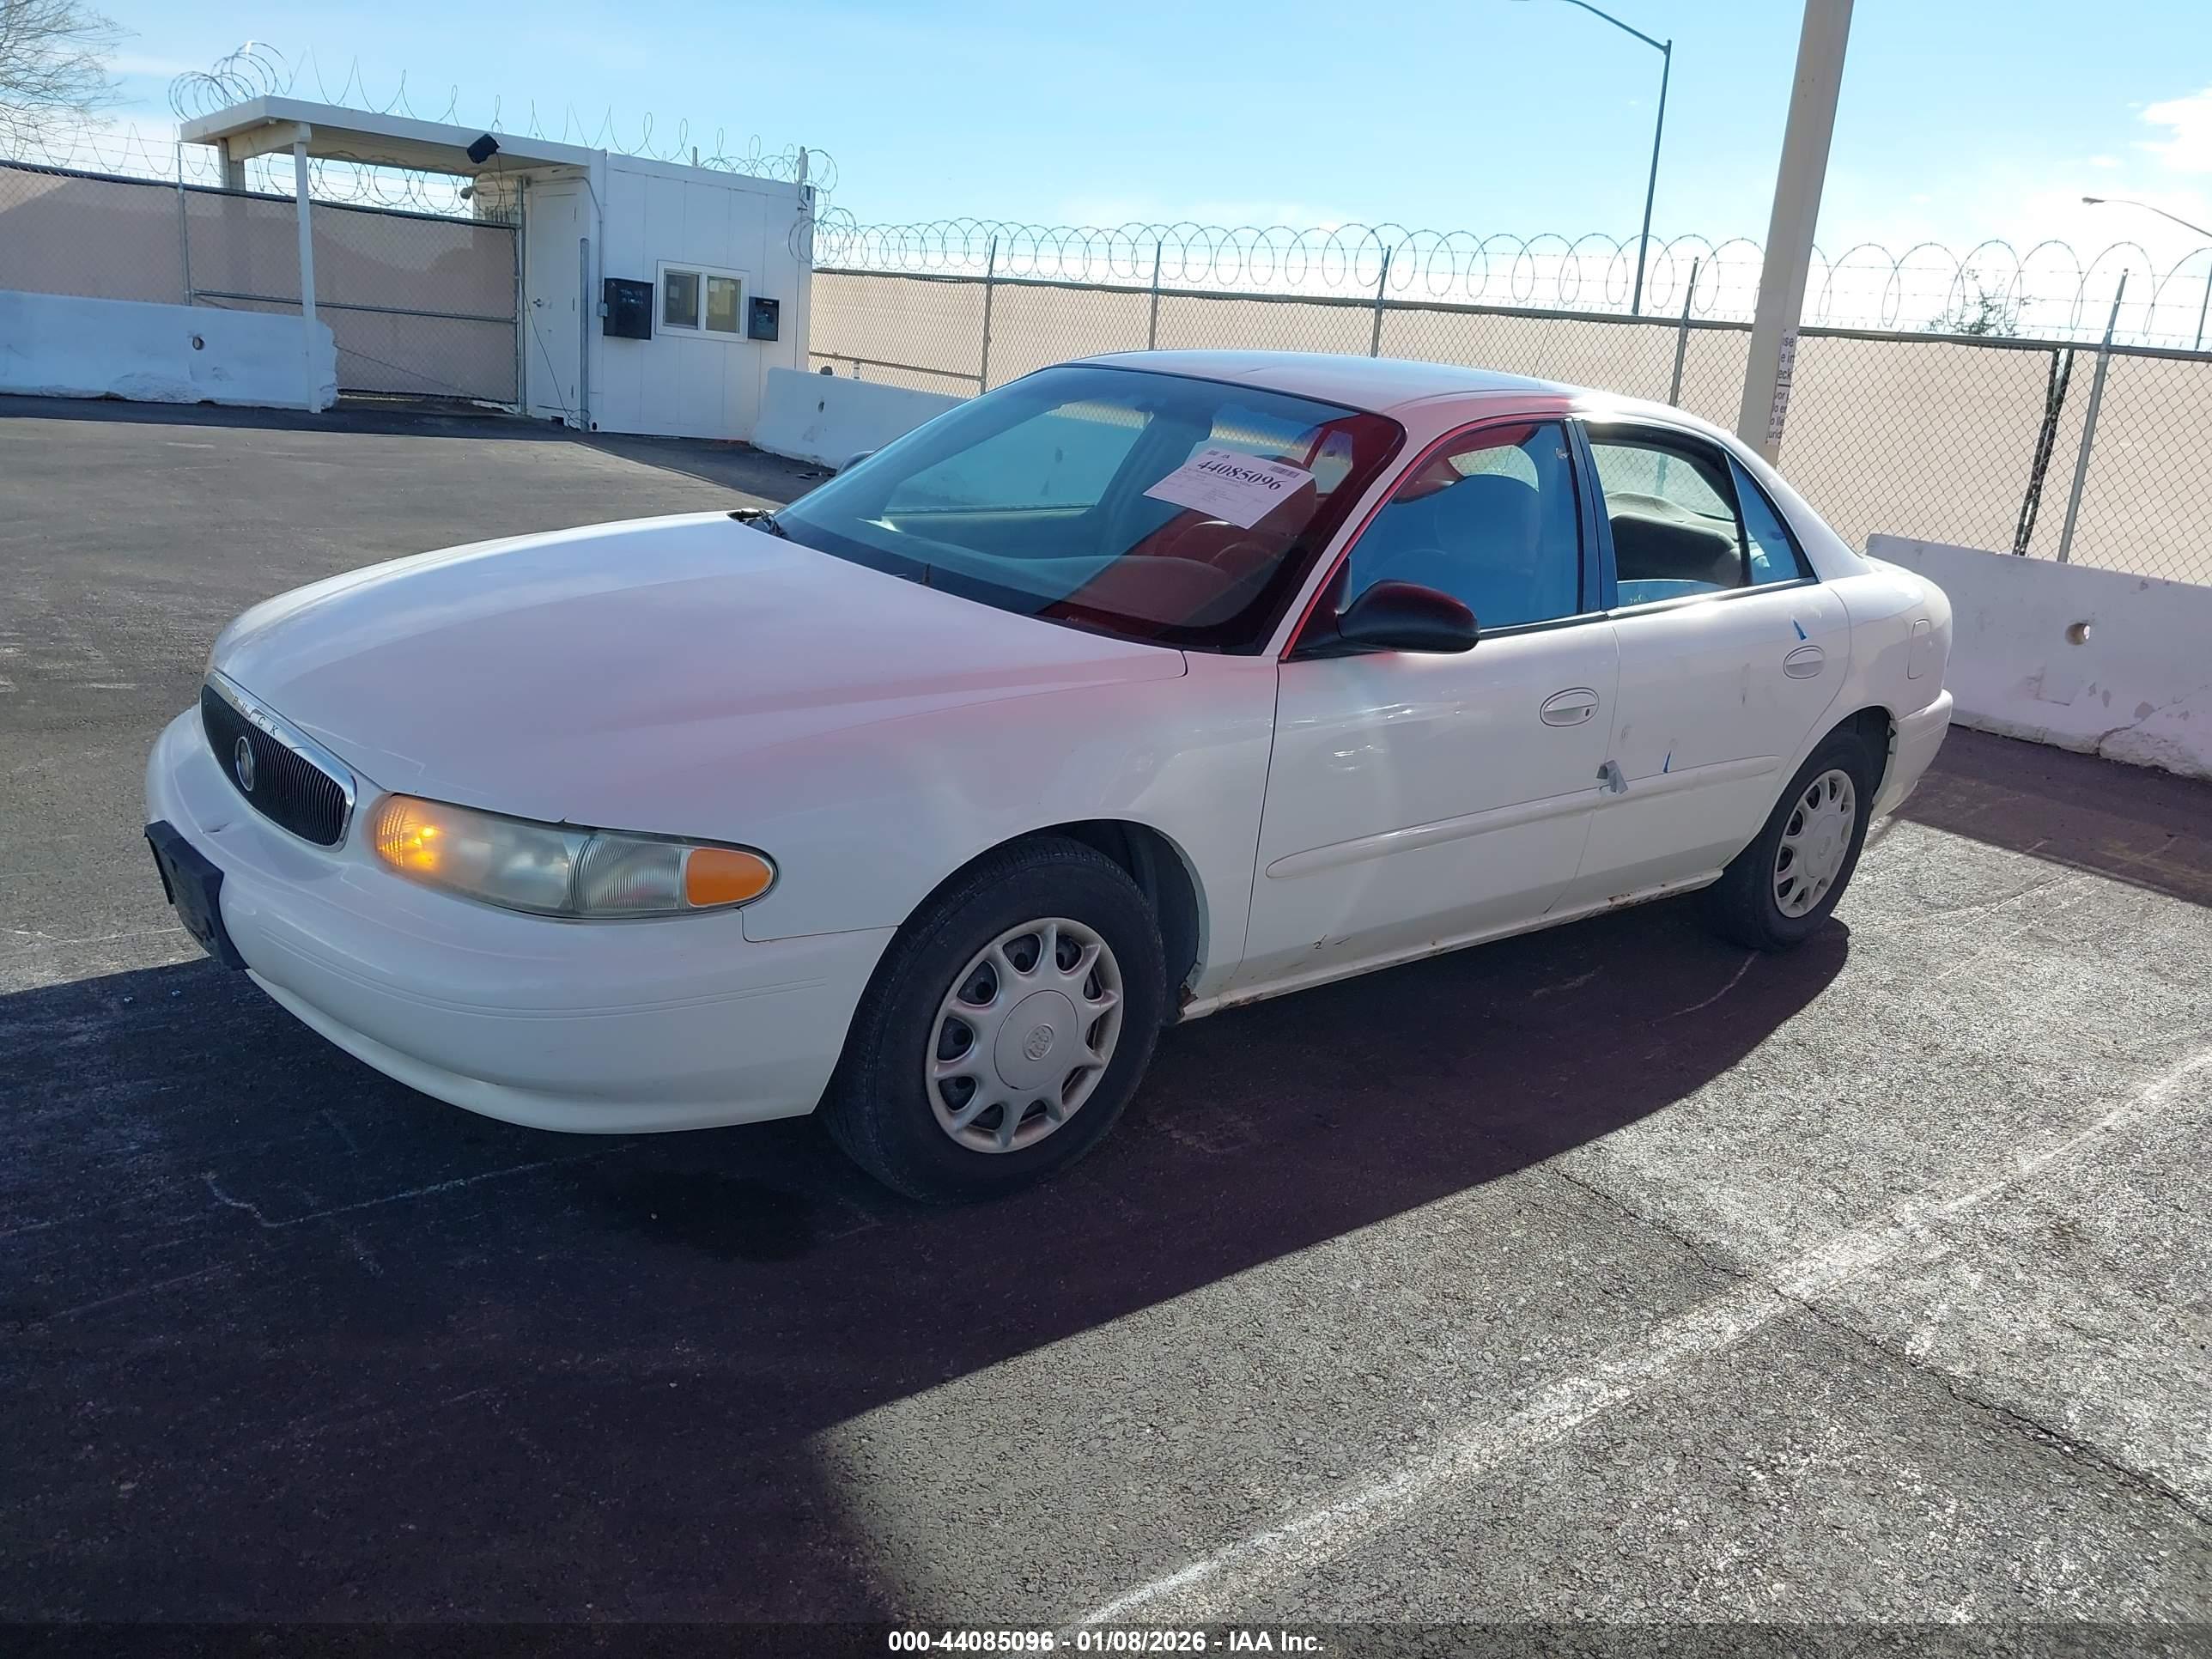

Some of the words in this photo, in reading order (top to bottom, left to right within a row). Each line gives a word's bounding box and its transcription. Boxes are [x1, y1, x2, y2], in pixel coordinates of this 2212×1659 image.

[1784, 337, 1794, 347] se
[1197, 460, 1287, 490] 44085096
[232, 696, 278, 736] BUICK
